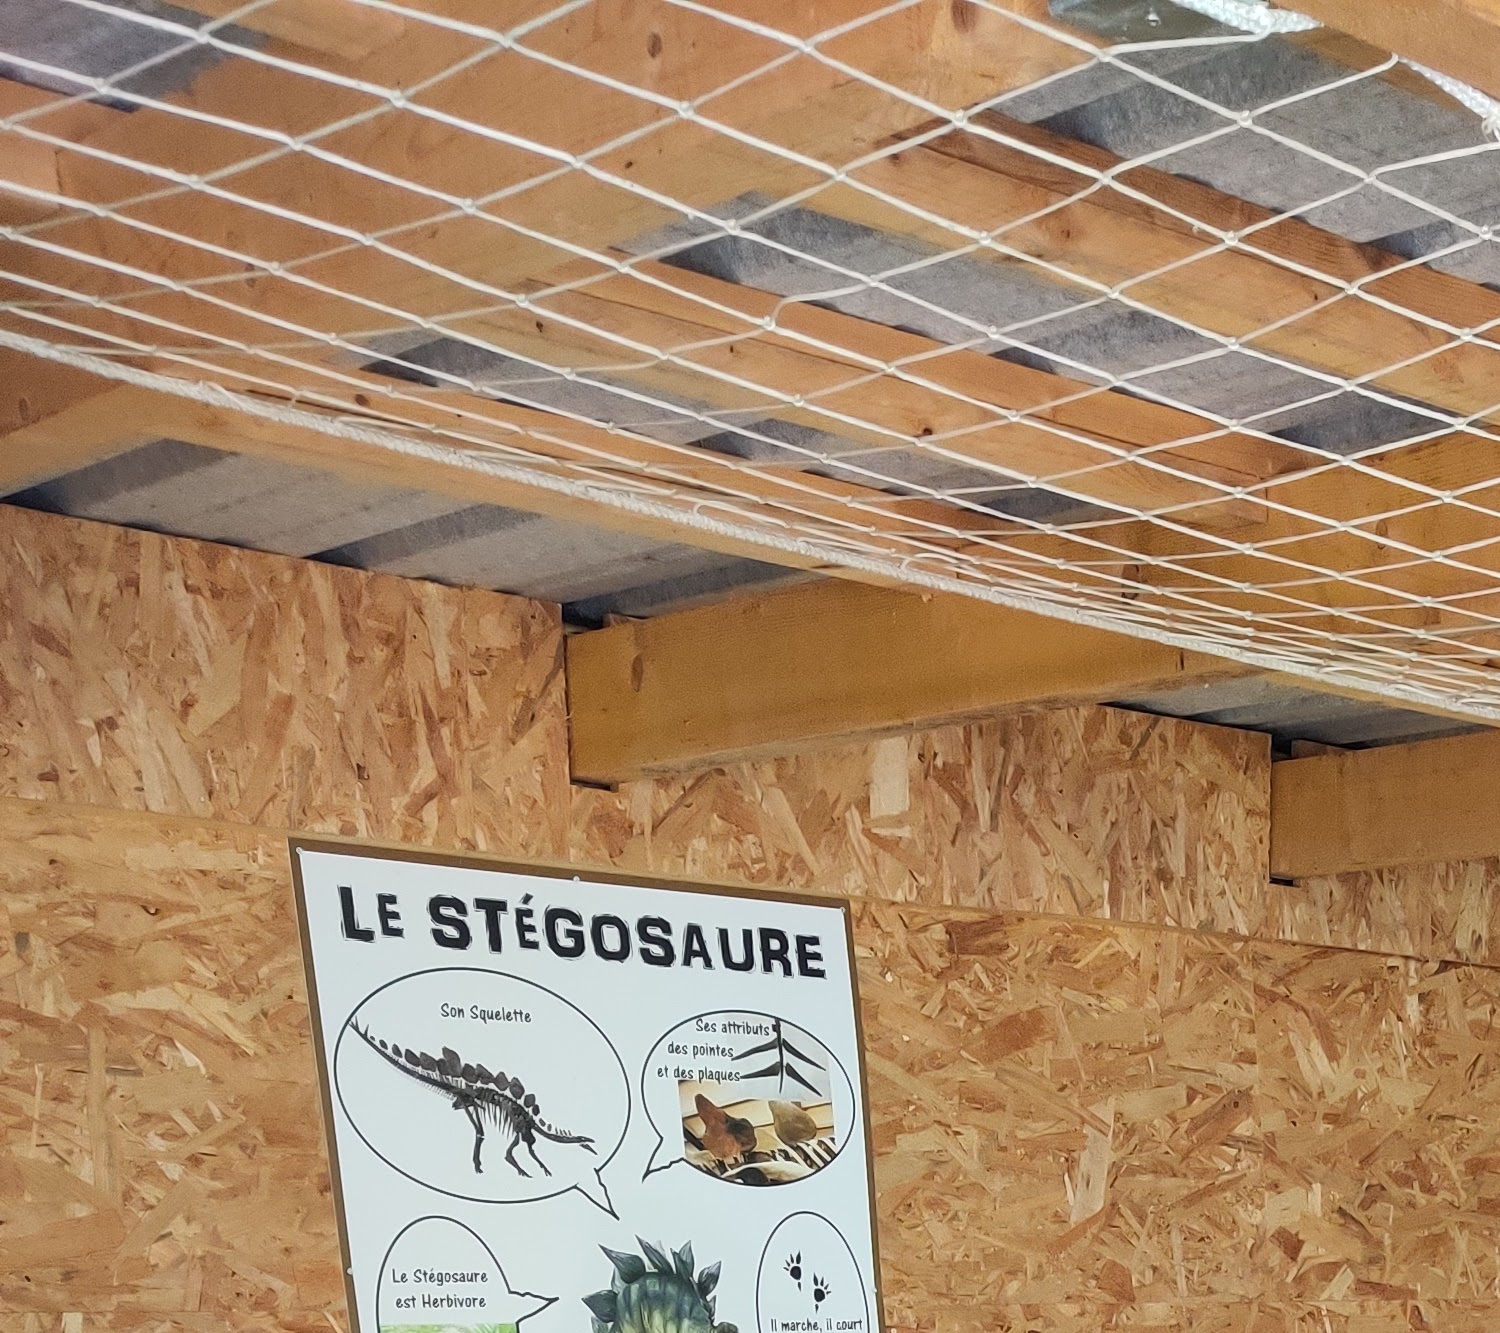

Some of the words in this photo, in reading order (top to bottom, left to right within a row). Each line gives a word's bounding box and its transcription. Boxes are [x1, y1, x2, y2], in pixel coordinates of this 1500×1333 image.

[338, 884, 405, 943] LE
[427, 892, 828, 980] STÉGOSAURE
[440, 1002, 465, 1018] Son
[469, 1004, 532, 1025] Squelette
[695, 1018, 717, 1033] Ses
[721, 1021, 770, 1036] attributs
[667, 1041, 688, 1055] des
[692, 1043, 734, 1059] pointes
[657, 1065, 669, 1078] et
[673, 1065, 694, 1080] des
[698, 1066, 740, 1085] plaques
[392, 1267, 408, 1284] Le
[413, 1267, 488, 1287] Stégosaure
[395, 1295, 417, 1309] est
[421, 1293, 487, 1309] Herbivore
[770, 1317, 778, 1332] Il
[781, 1317, 823, 1333] marche,
[825, 1317, 833, 1331] il
[836, 1318, 863, 1331] court
